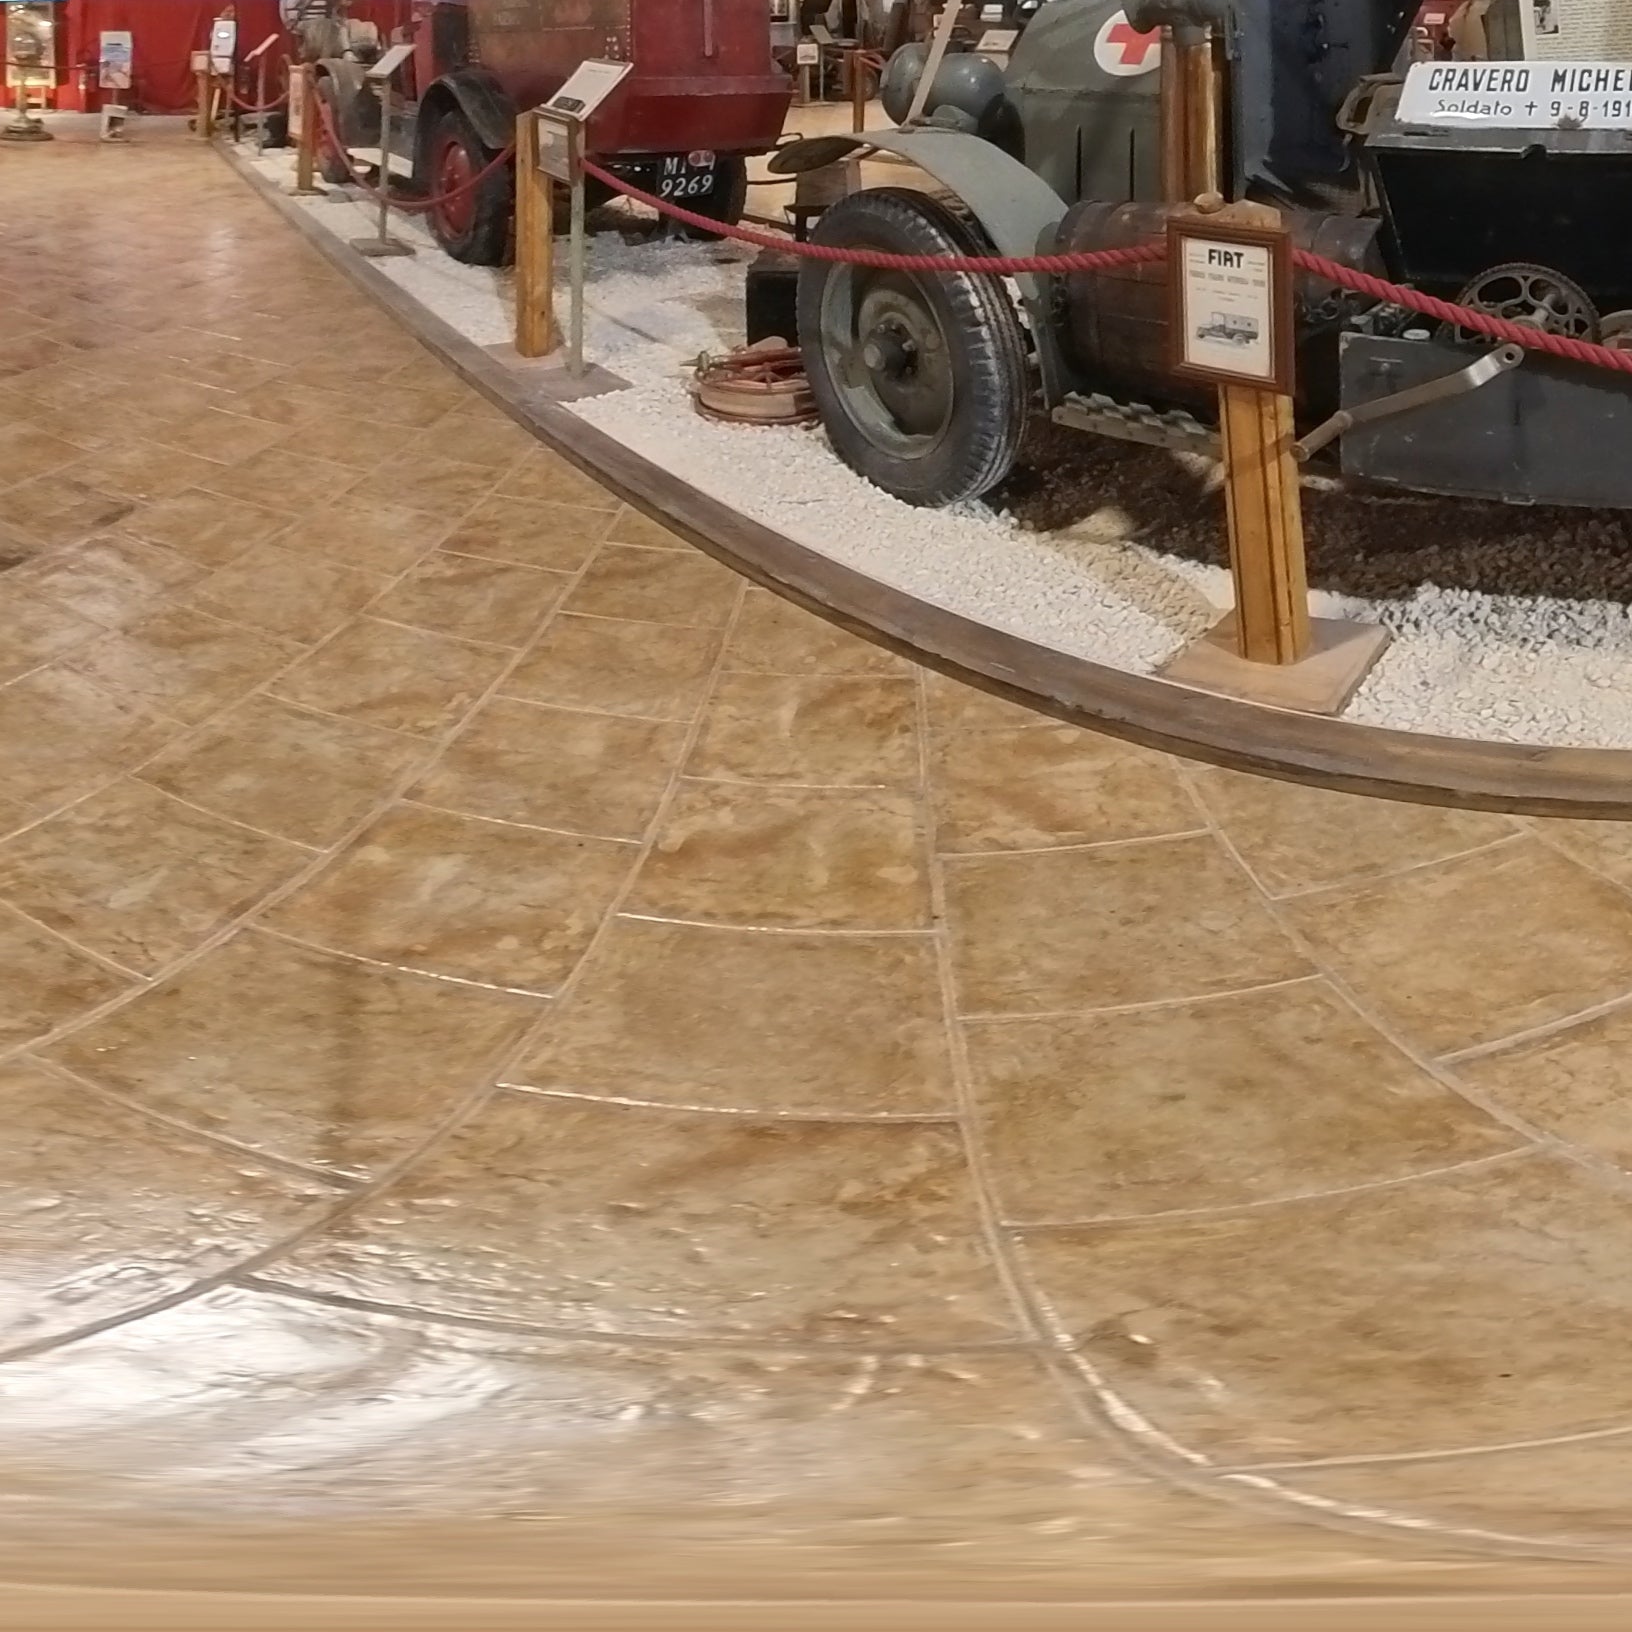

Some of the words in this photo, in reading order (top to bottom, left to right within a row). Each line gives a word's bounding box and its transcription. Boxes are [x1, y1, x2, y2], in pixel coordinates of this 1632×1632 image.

[1428, 68, 1529, 92] CRAVERO
[1434, 99, 1512, 117] Soldato
[659, 174, 713, 197] 9269
[1208, 248, 1244, 268] FIAT
